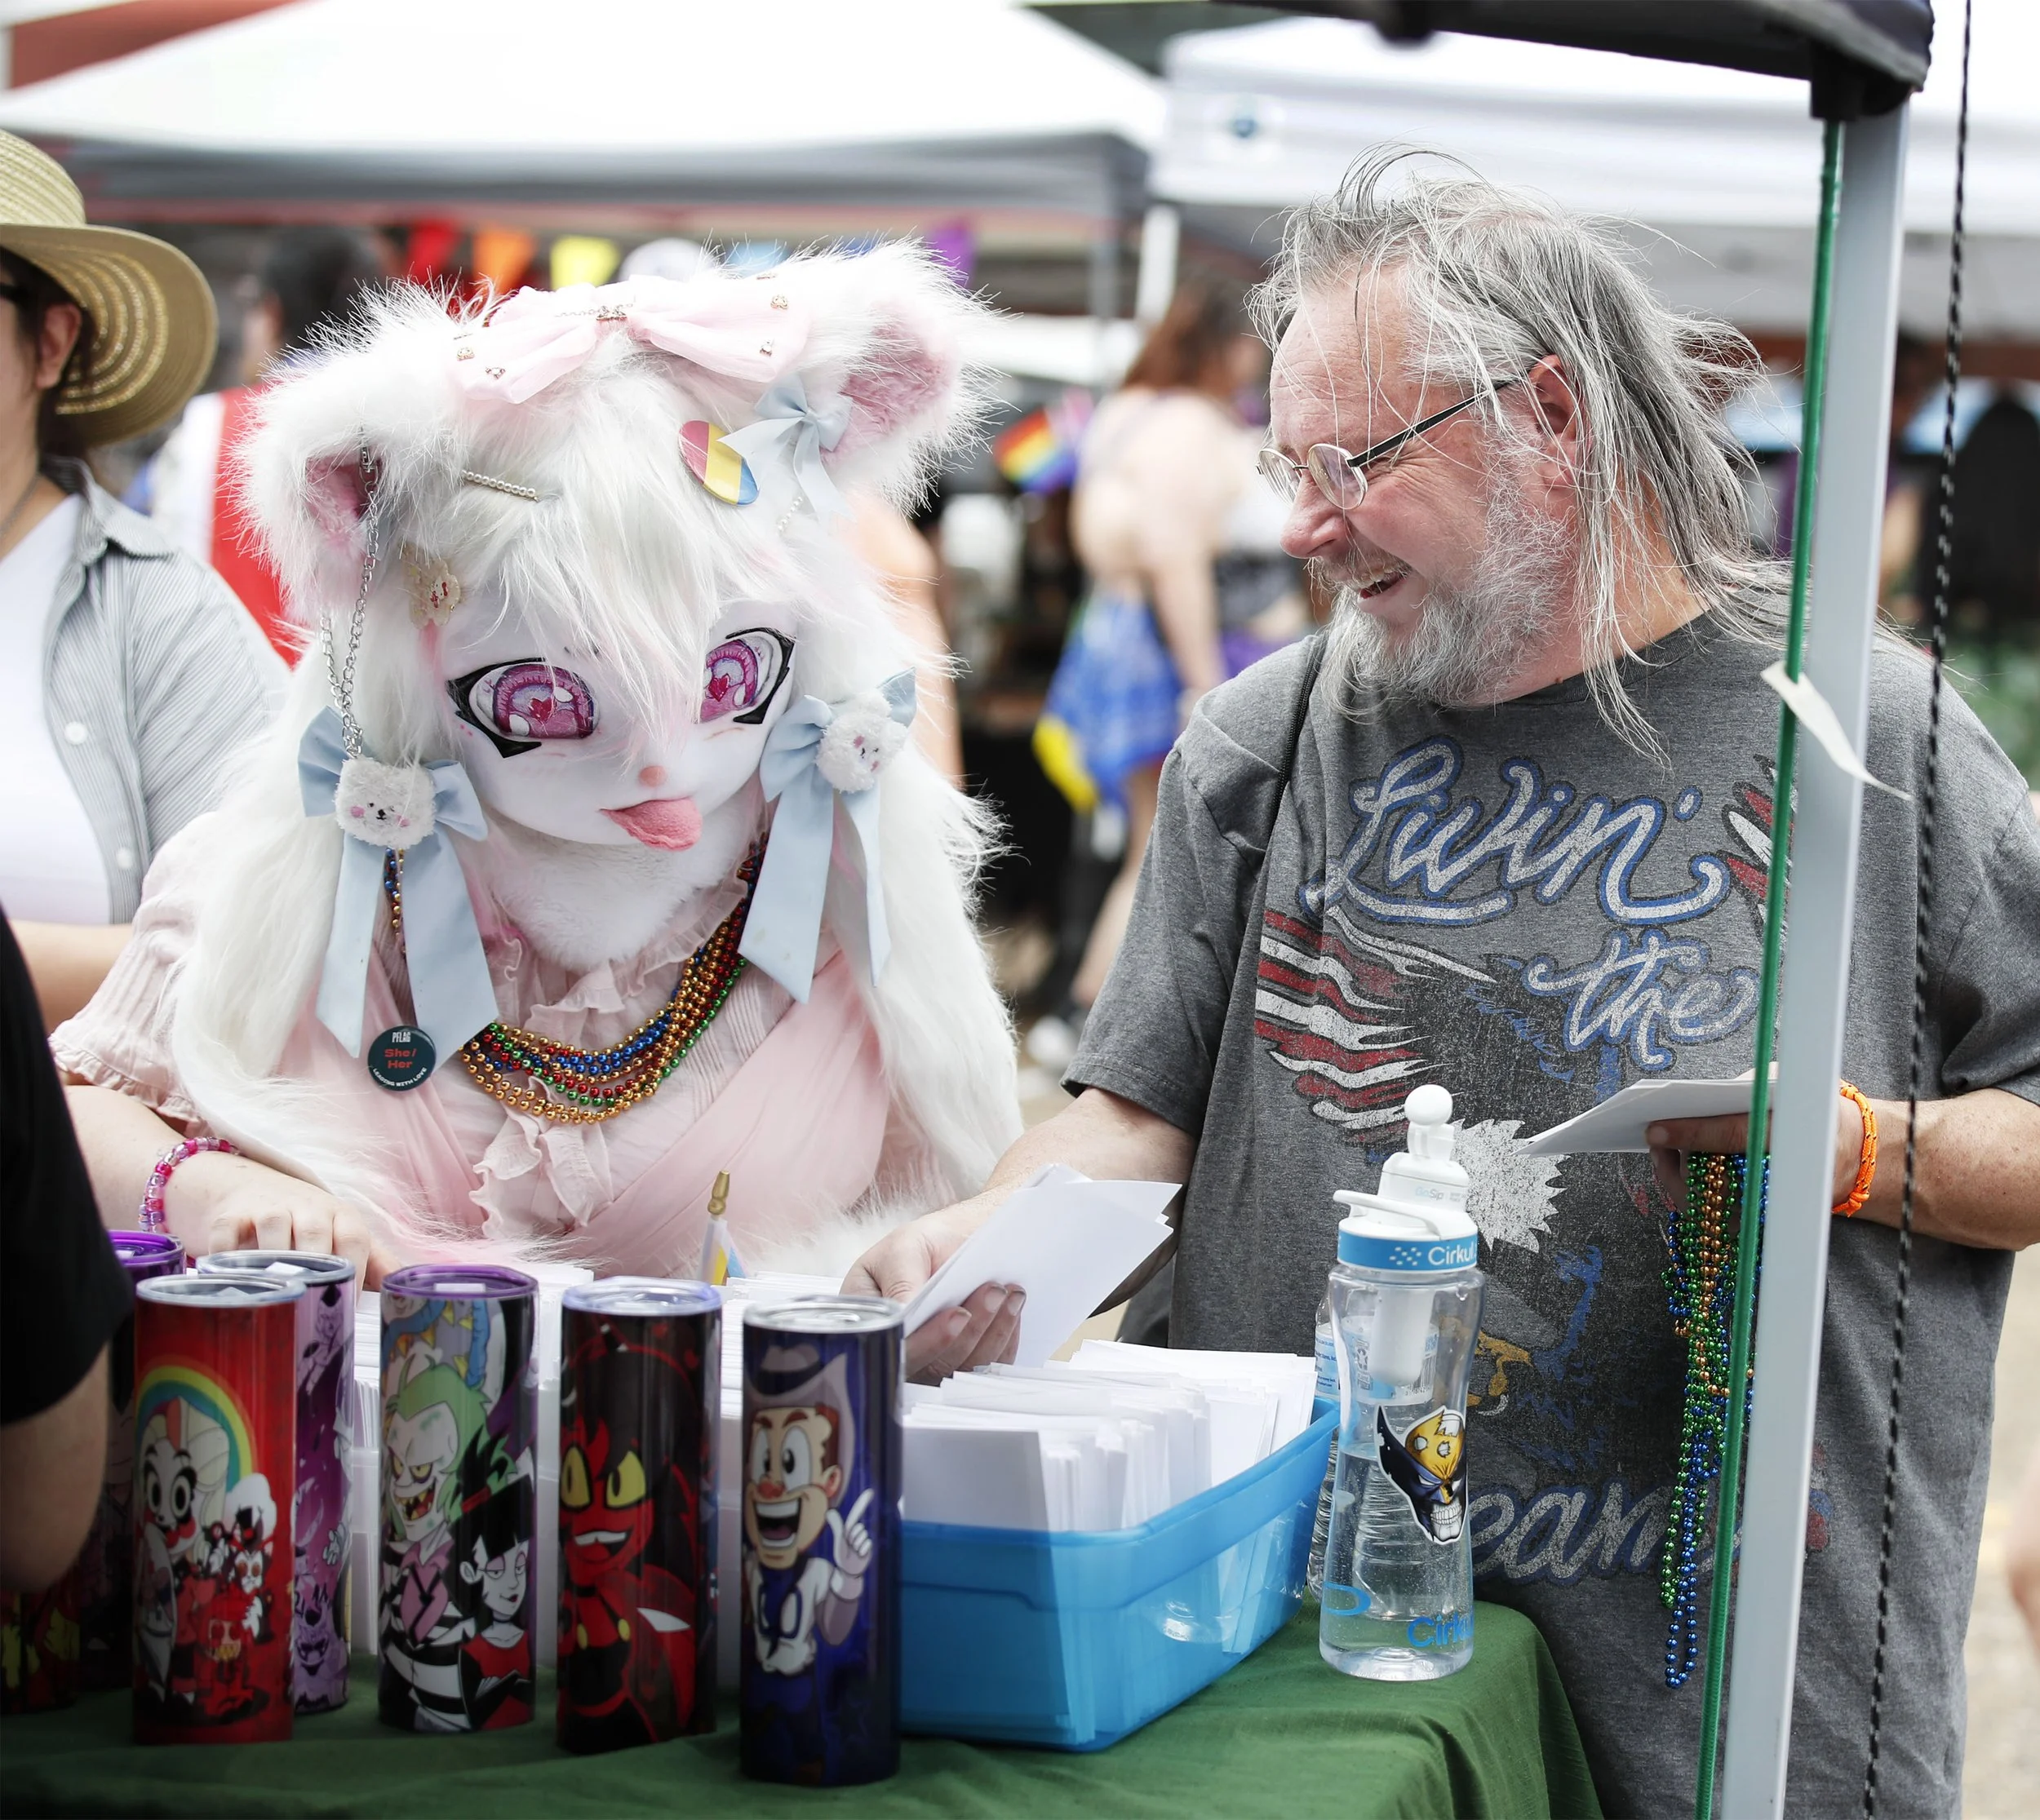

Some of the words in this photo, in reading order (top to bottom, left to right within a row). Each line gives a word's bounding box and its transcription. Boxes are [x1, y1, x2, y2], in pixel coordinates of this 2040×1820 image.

[1523, 925, 1761, 1069] the
[392, 1031, 410, 1043] PFLAG
[388, 1061, 412, 1069] Her
[373, 1068, 395, 1086] LEADING
[396, 1078, 414, 1087] WITH
[414, 1067, 427, 1081] LOVE
